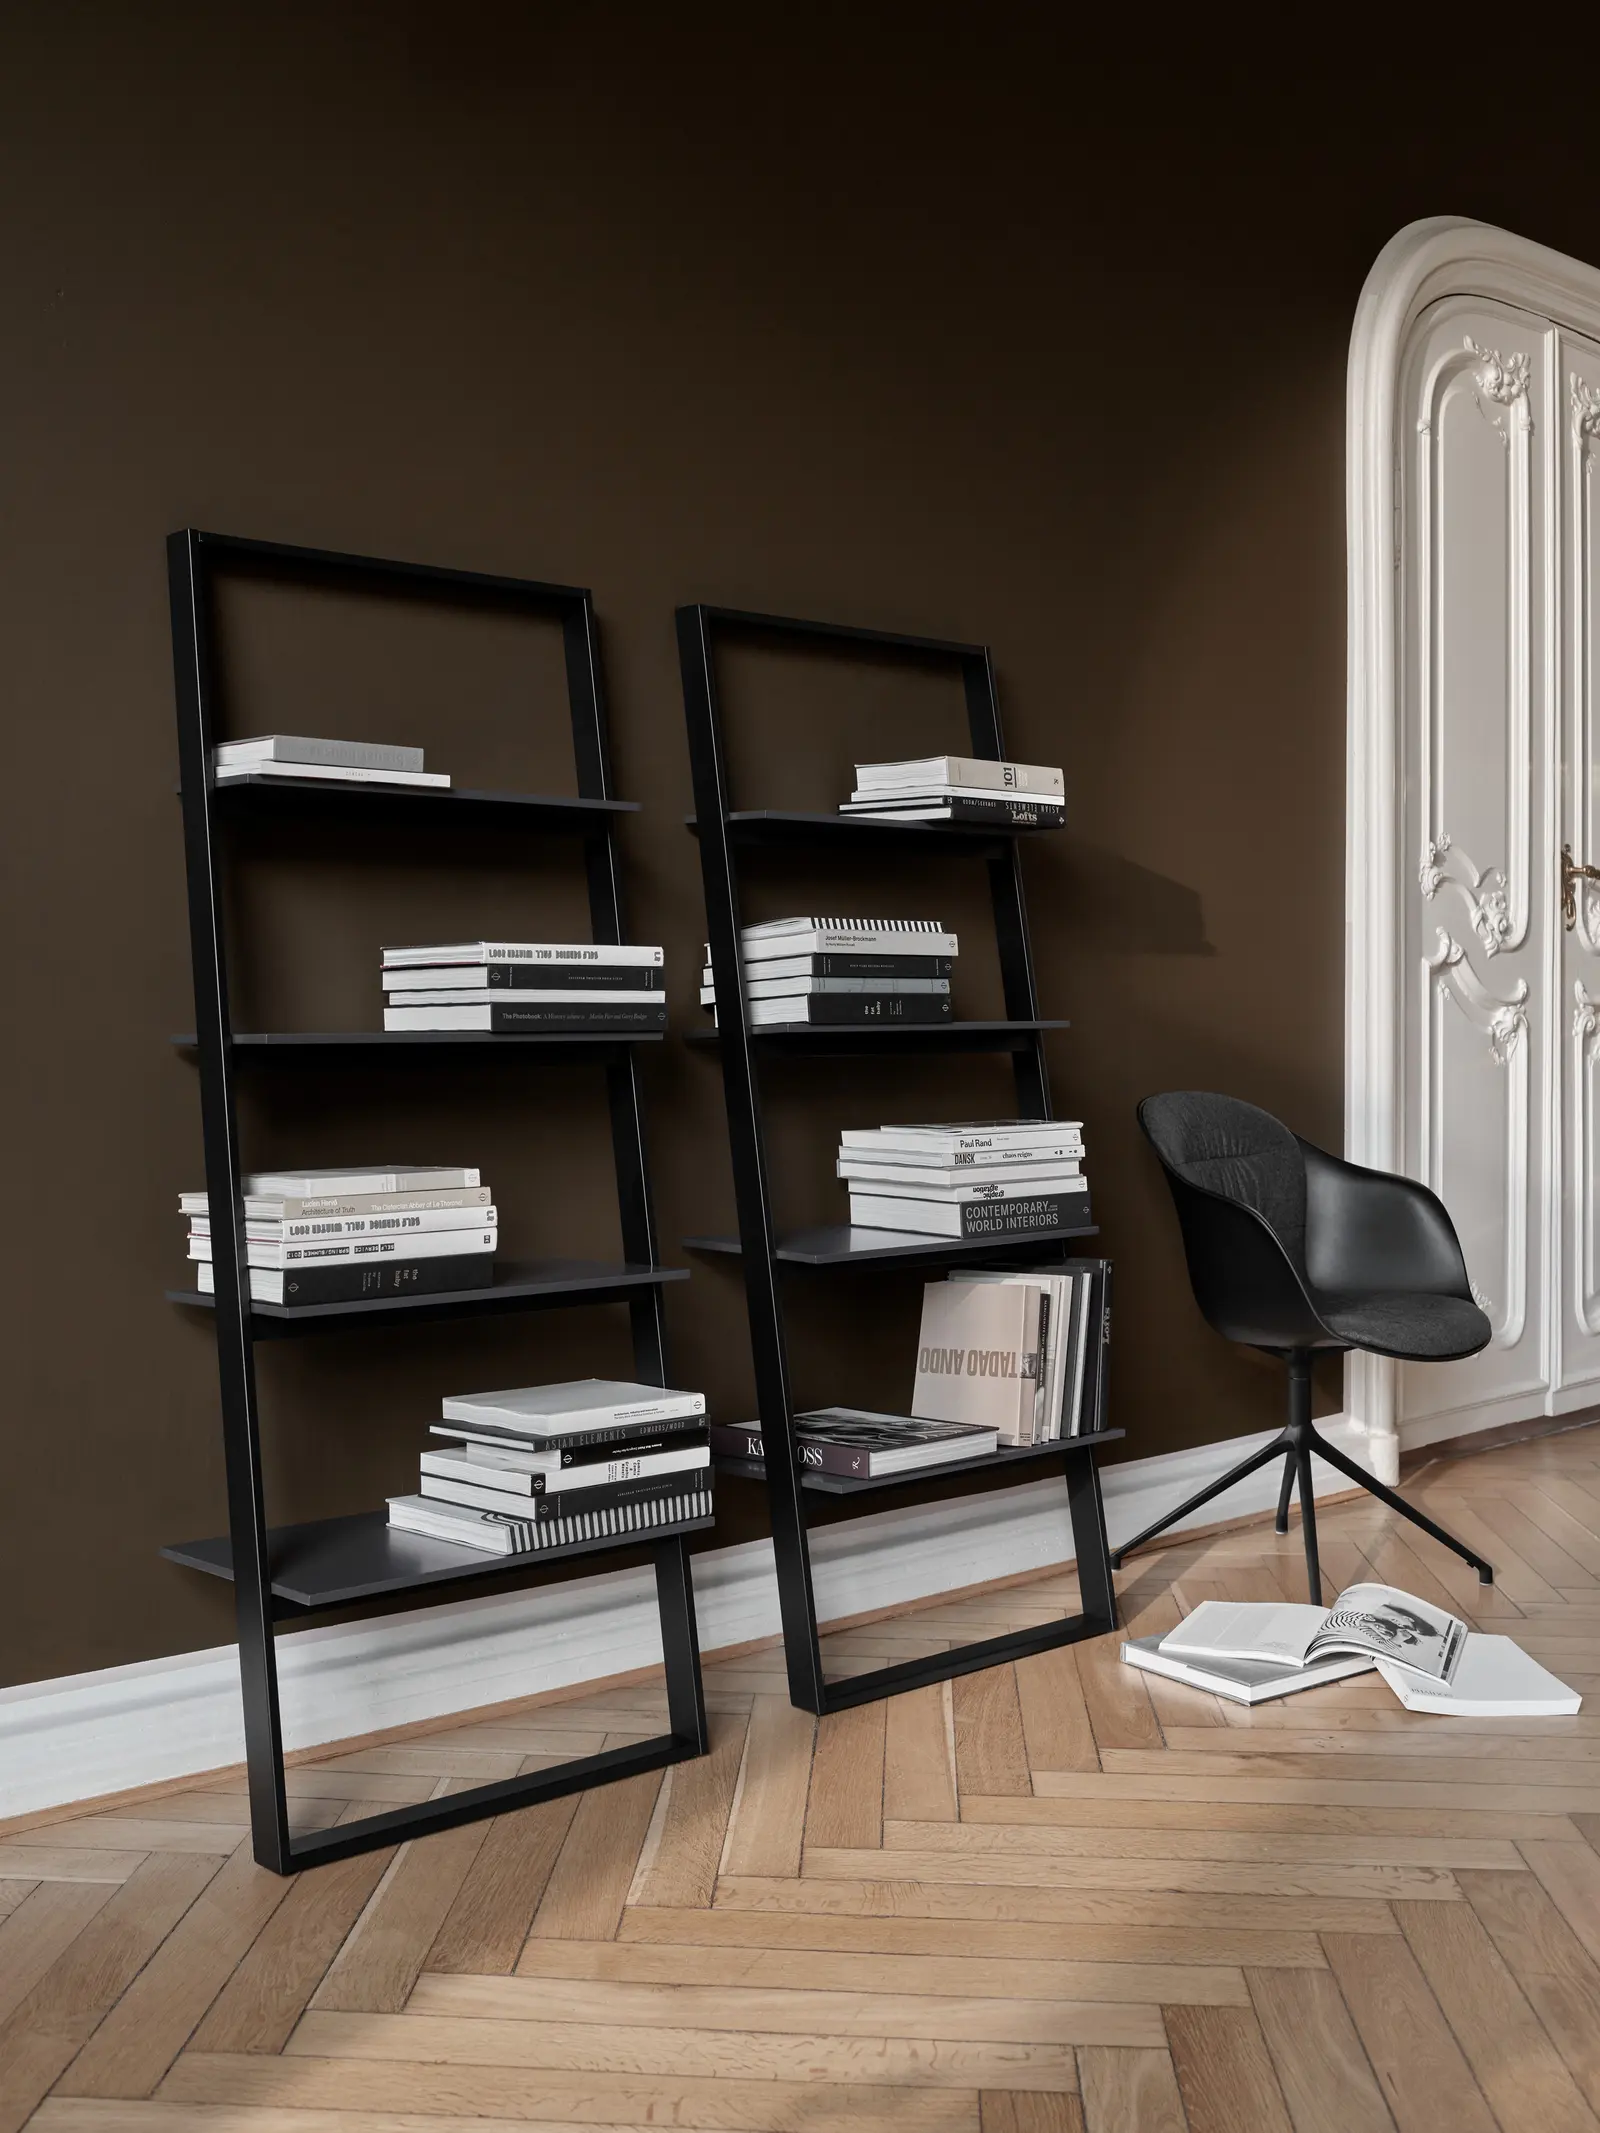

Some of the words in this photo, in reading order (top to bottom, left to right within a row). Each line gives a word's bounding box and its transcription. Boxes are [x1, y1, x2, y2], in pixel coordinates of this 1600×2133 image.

[1003, 767, 1013, 787] 101
[1005, 801, 1038, 813] ELEMENTS
[1040, 805, 1060, 814] ASIAN
[1011, 810, 1038, 821] Lofts
[583, 950, 599, 960] SELF
[502, 1012, 513, 1020] The
[960, 1139, 974, 1148] Paul
[975, 1138, 992, 1147] Rand
[955, 1153, 976, 1165] DANSK
[1017, 1151, 1033, 1159] reigns
[972, 1184, 999, 1193] agitation
[983, 1189, 1005, 1200] graphic
[301, 1208, 334, 1216] Architecture
[342, 1206, 356, 1214] Truth
[408, 1201, 426, 1210] Abbey
[965, 1200, 1049, 1219] CONTEMPORARY
[345, 1221, 365, 1231] FALL
[369, 1218, 401, 1230] SERVICE
[401, 1217, 421, 1227] SELF
[966, 1218, 1003, 1233] WORLD
[1006, 1213, 1059, 1229] INTERIORS
[311, 1222, 343, 1234] WINTER
[303, 1246, 350, 1258] SPRING/SUMMER
[354, 1244, 379, 1254] SERVICE
[380, 1243, 394, 1252] SELF
[287, 1250, 302, 1260] 2013
[918, 1347, 965, 1375] ANDO
[966, 1349, 1018, 1378] TADAO
[544, 1436, 574, 1450] ASIAN
[579, 1428, 627, 1446] ELEMENTS
[639, 1421, 685, 1434] EDWARDS/WOOD
